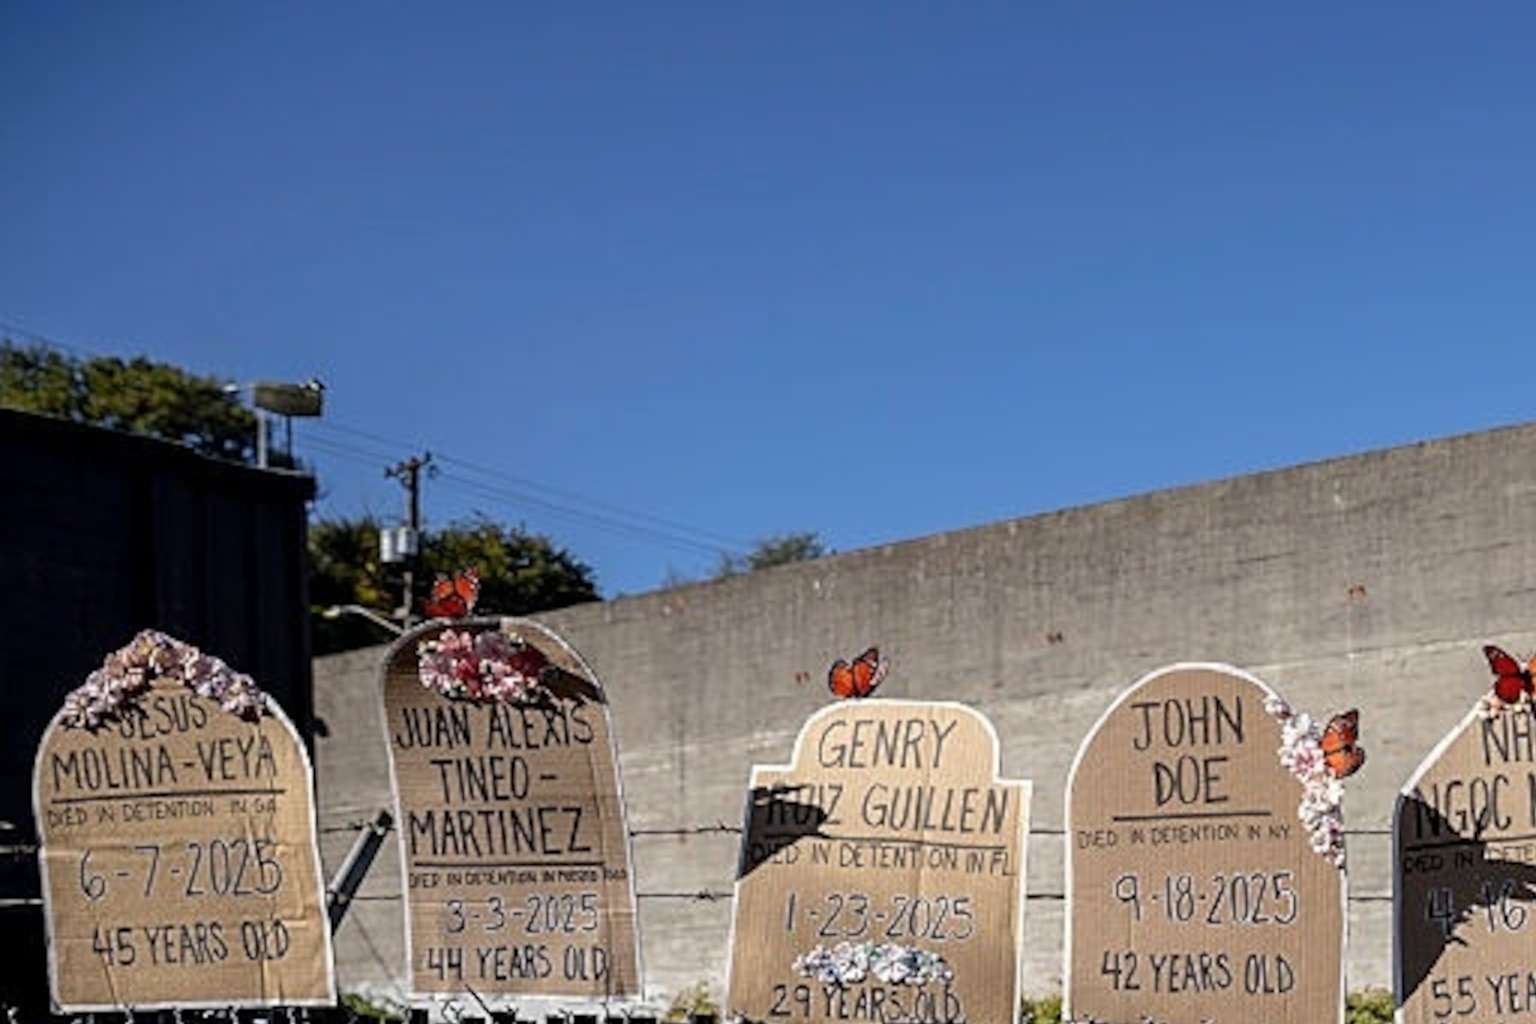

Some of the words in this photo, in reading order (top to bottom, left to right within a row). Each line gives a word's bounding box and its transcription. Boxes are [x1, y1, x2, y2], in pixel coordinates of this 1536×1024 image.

[119, 695, 208, 740] JESUS
[397, 705, 471, 749] JUAN
[488, 702, 593, 749] ALEXIS
[1132, 696, 1244, 750] JOHN
[52, 736, 277, 791] MOLINA-VEYA
[818, 719, 957, 768] GENRY
[1154, 755, 1229, 806] DOE
[48, 808, 87, 827] DIED
[100, 806, 115, 823] IN
[123, 798, 214, 822] DETENTION
[231, 798, 247, 814] IN
[255, 798, 277, 814] GA
[409, 806, 591, 856] MARTINEZ
[862, 783, 1009, 834] GUILLEN
[1079, 829, 1118, 849] DIED
[1131, 828, 1145, 844] IN
[1152, 824, 1242, 844] DETENTION
[1250, 825, 1260, 839] IN
[1269, 823, 1291, 840] NY
[80, 837, 282, 899] 6-7-2025
[447, 871, 461, 886] IN
[465, 869, 537, 886] DETENTION
[544, 868, 556, 883] IN
[812, 843, 829, 865] IN
[840, 843, 958, 870] DETENTION
[965, 852, 983, 874] IN
[990, 851, 1017, 876] FL
[1455, 852, 1474, 868] IN
[447, 893, 598, 932] 3-3-2025
[787, 892, 975, 940] 1-23-2025
[1115, 873, 1298, 924] 9-18-2025
[92, 925, 137, 966] 45
[145, 922, 228, 965] YEARS
[242, 918, 289, 961] OLD
[428, 947, 463, 981] 44
[476, 944, 551, 980] YEARS
[564, 944, 611, 980] OLD
[1101, 951, 1140, 990] 42
[1150, 953, 1233, 993] YEARS
[1244, 953, 1295, 994] OLD
[769, 984, 810, 1017] 29
[822, 984, 901, 1022] YEARS
[914, 985, 962, 1021] OLD
[1431, 976, 1477, 1018] 55
